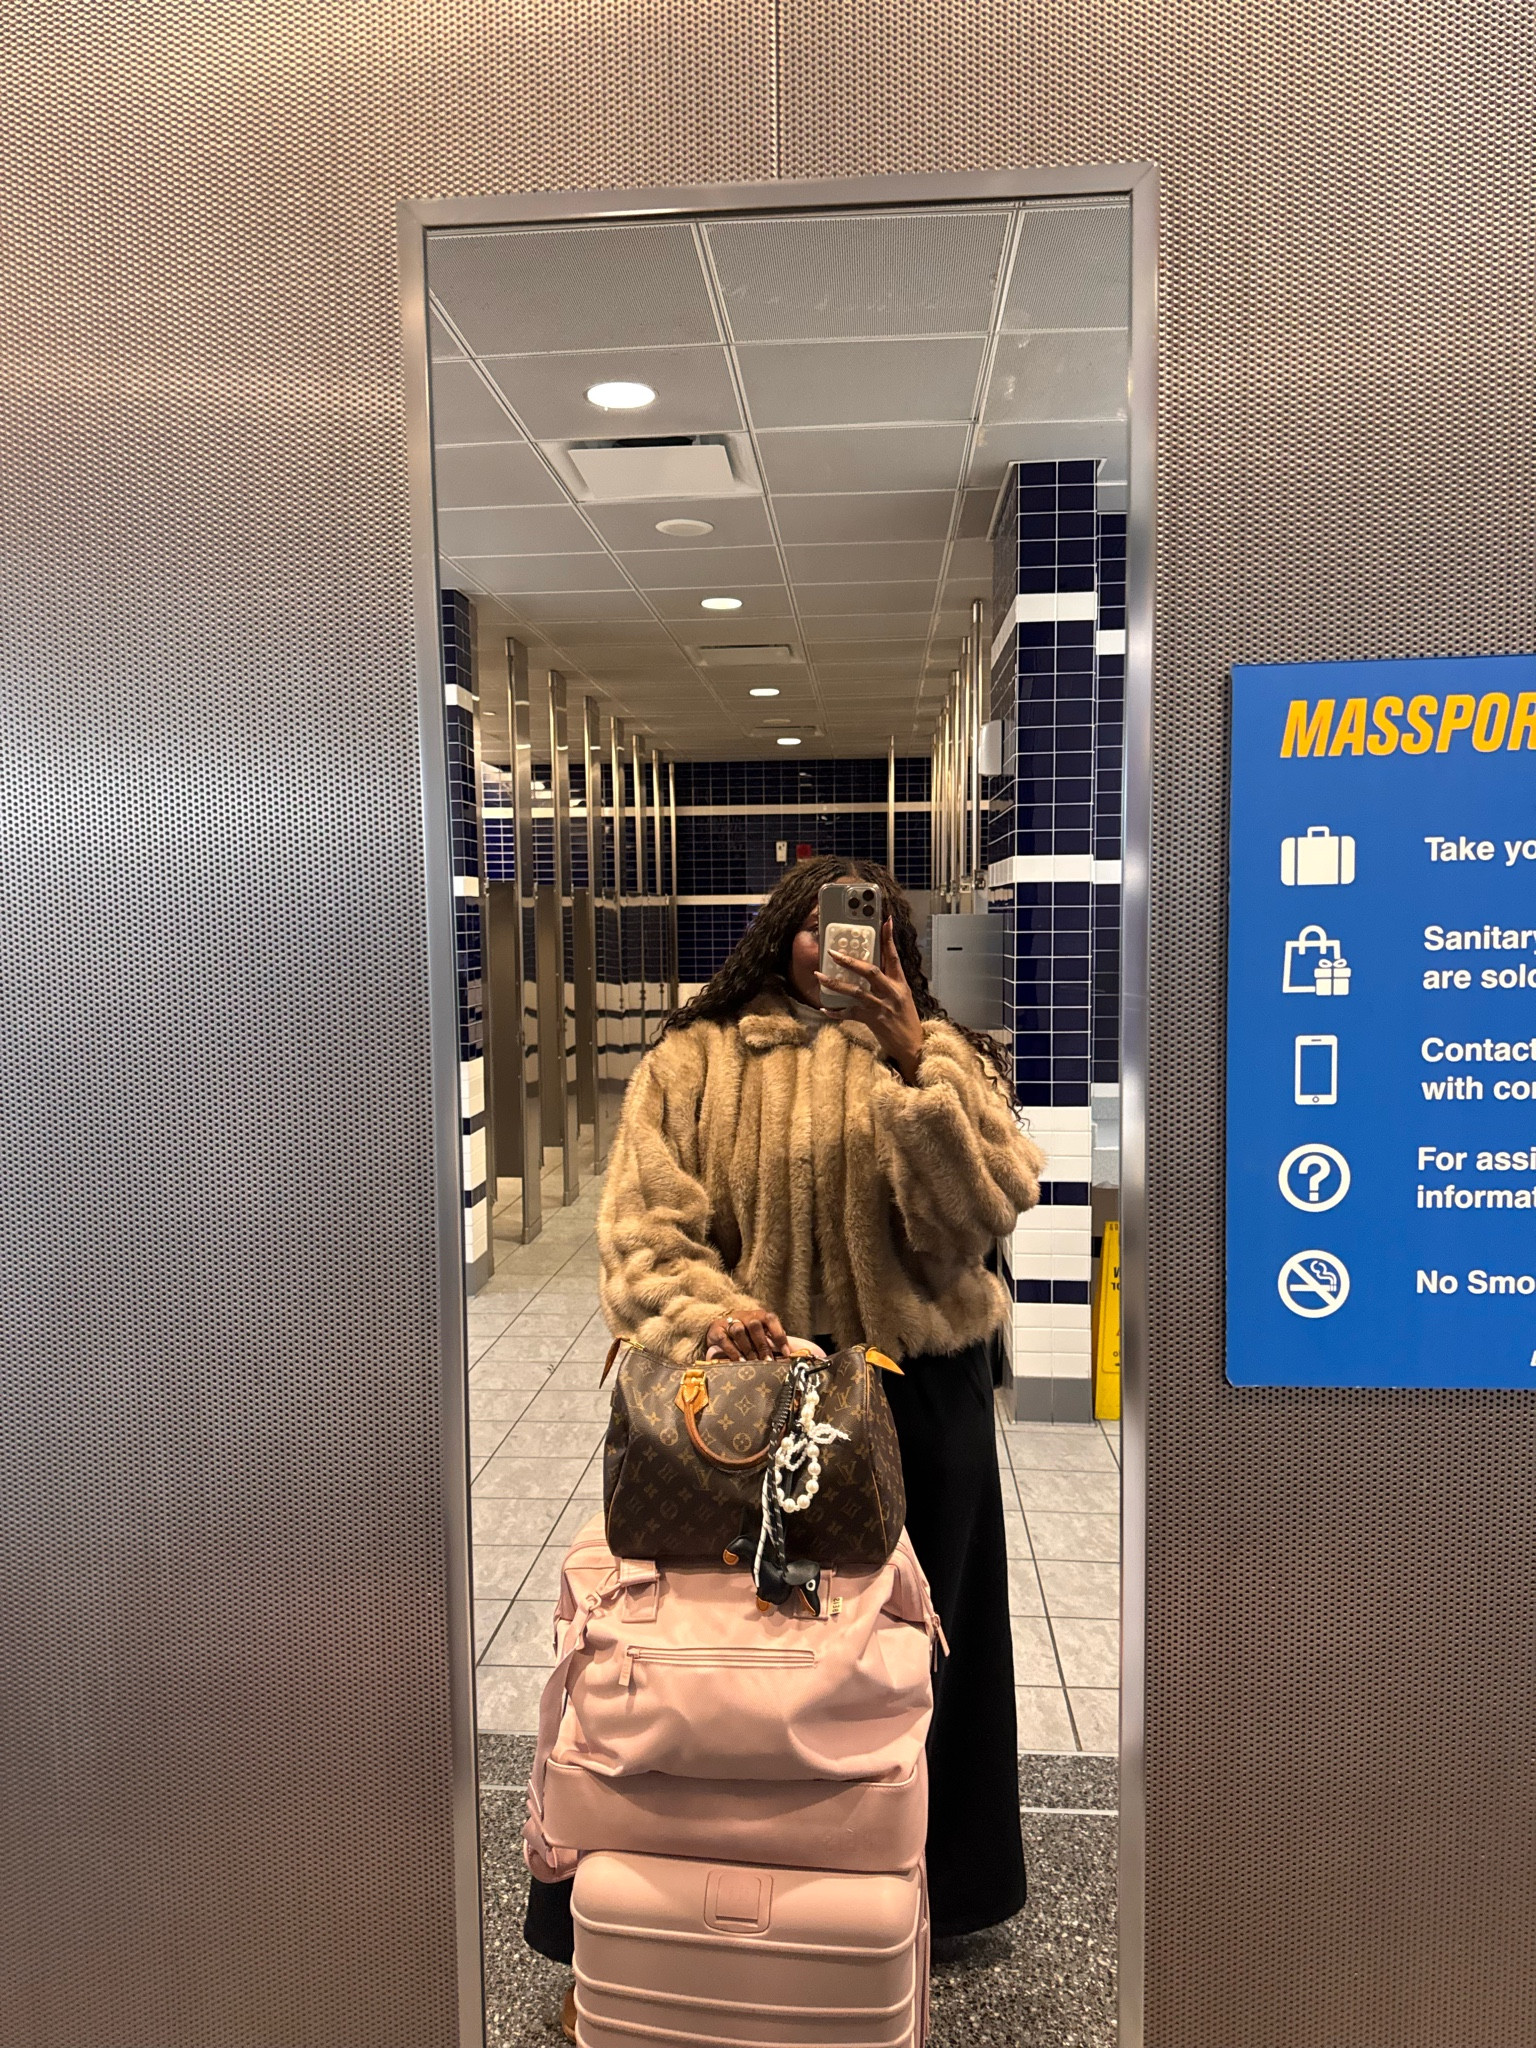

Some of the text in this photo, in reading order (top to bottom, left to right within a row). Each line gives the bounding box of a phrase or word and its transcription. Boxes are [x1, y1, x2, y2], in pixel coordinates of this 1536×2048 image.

[1280, 691, 1536, 758] MASSPOR
[1424, 836, 1536, 867] Take yo
[1424, 924, 1536, 956] Sanitar
[1423, 969, 1472, 990] are
[1421, 1036, 1536, 1063] Contact
[1421, 1075, 1536, 1101] with co
[1418, 1146, 1536, 1172] For assi
[1417, 1269, 1536, 1295] No Smo
